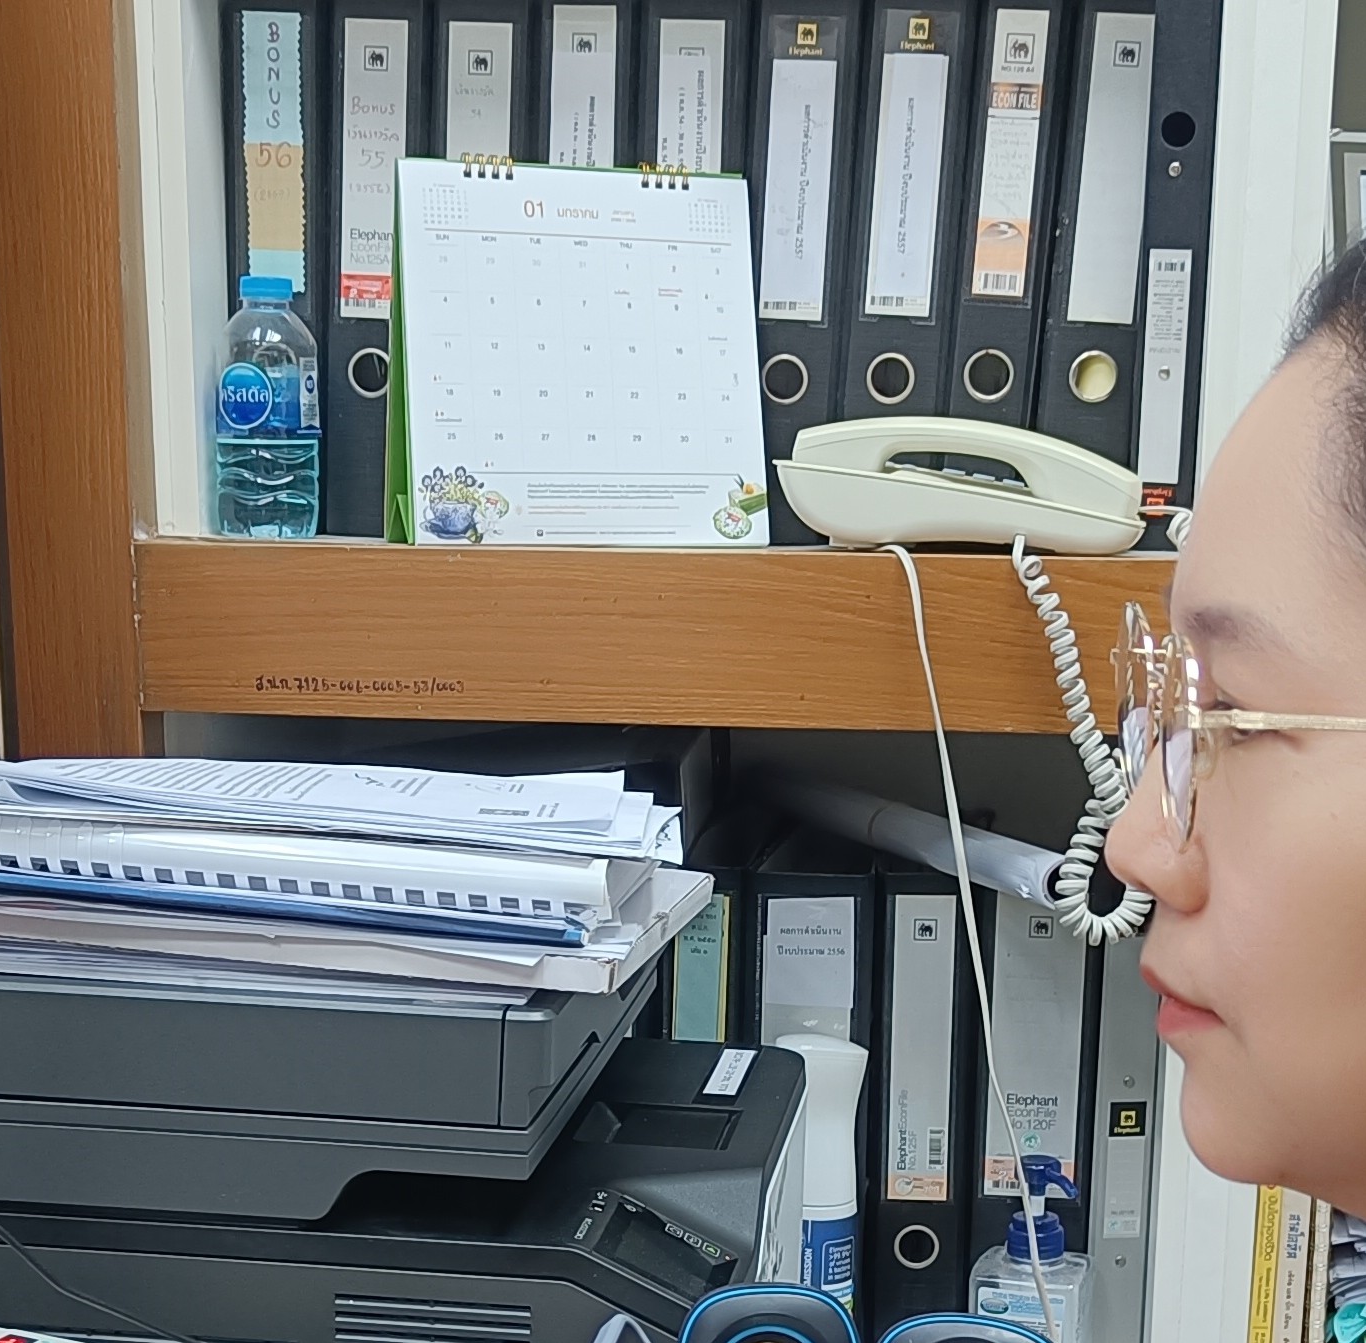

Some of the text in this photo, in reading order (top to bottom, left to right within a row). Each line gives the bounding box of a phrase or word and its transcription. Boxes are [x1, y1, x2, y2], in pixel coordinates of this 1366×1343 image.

[266, 21, 281, 129] BONUS
[350, 96, 396, 116] Bonus
[992, 91, 1038, 109] ECON FILE
[255, 142, 292, 168] 56
[358, 148, 385, 169] 55
[523, 200, 599, 220] 01 มกราคม
[350, 228, 394, 246] Elephan
[827, 947, 846, 956] 2556
[1006, 1093, 1059, 1106] Elephant
[1007, 1106, 1057, 1118] EconFile
